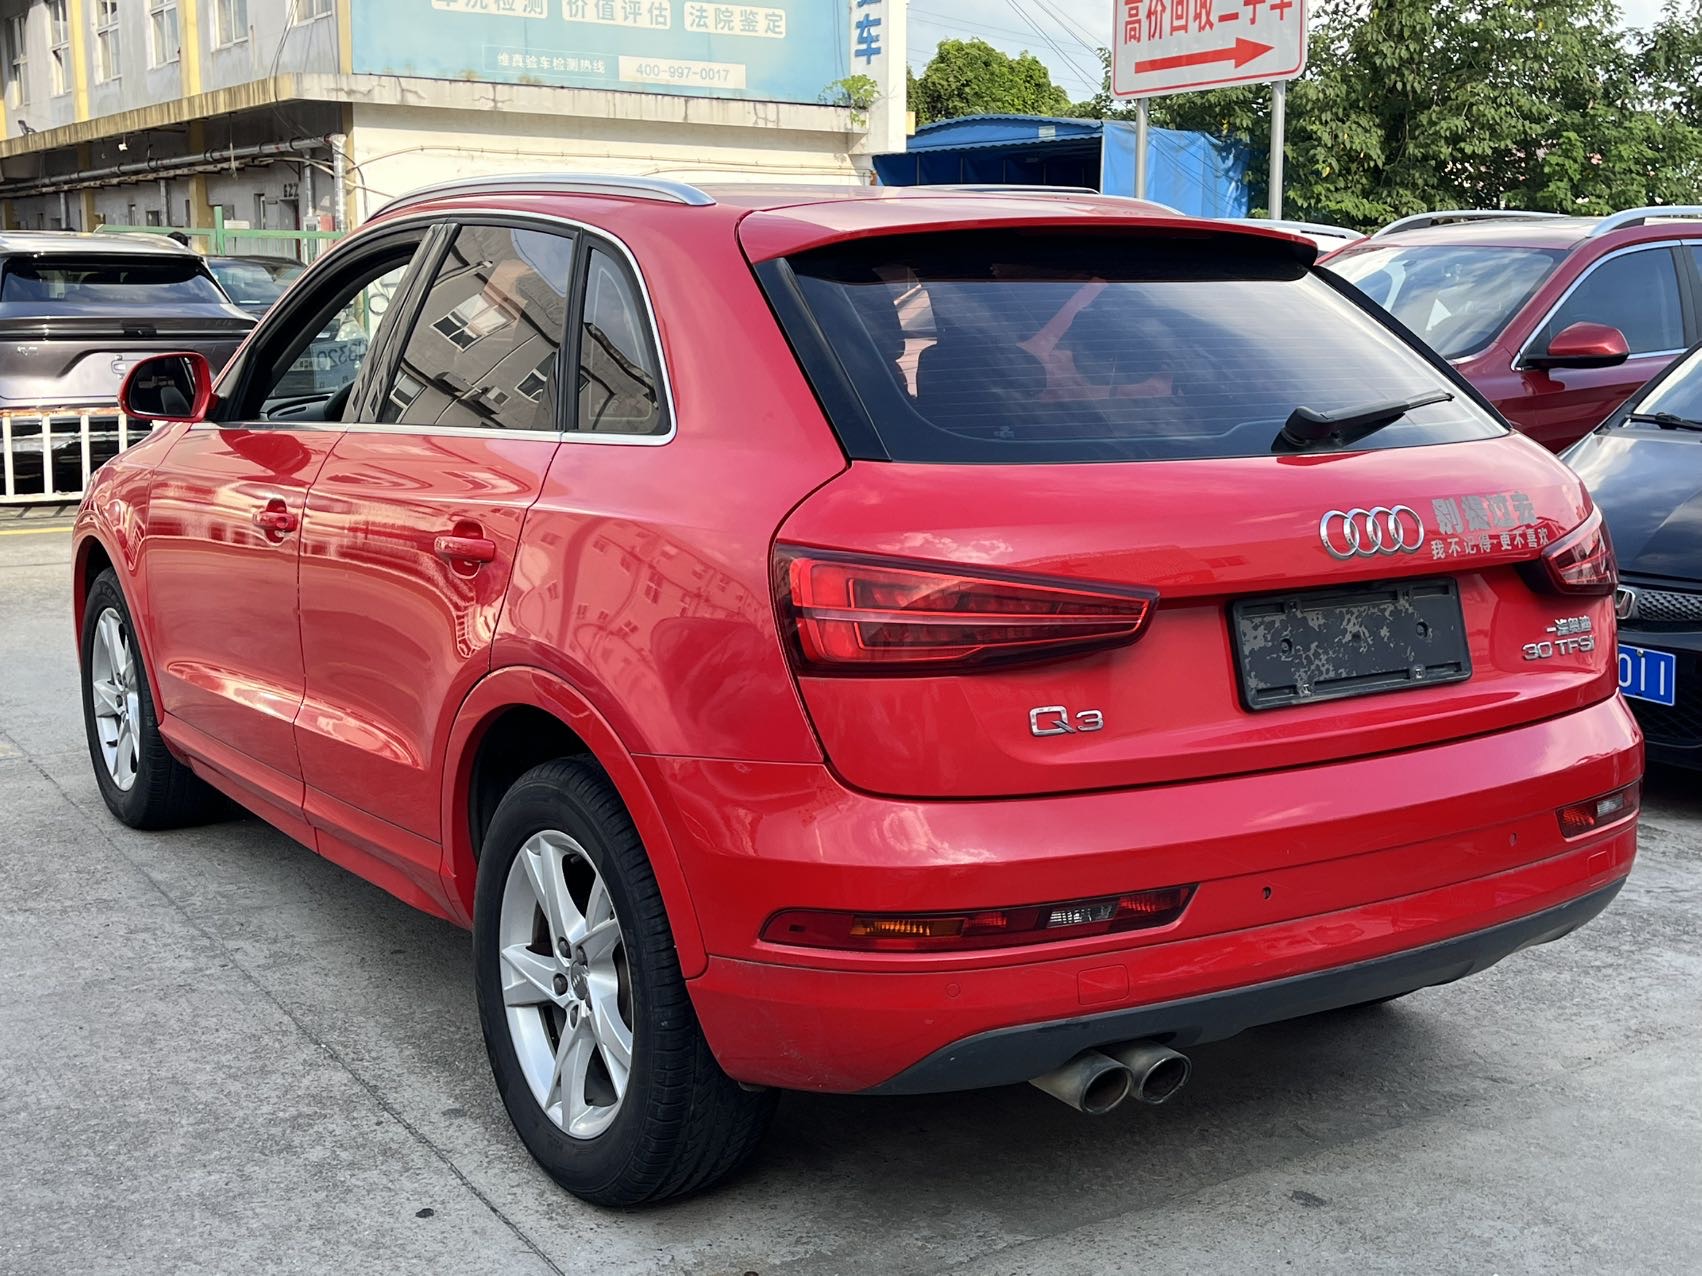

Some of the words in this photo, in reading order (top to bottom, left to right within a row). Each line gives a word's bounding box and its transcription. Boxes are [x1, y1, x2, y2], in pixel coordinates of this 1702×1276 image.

[566, 0, 669, 26] 价值评估
[689, 5, 783, 34] 法院鉴定
[855, 0, 881, 65] 车
[636, 64, 730, 82] 400-997-0017
[1523, 642, 1553, 660] 30
[1029, 705, 1104, 736] Q3
